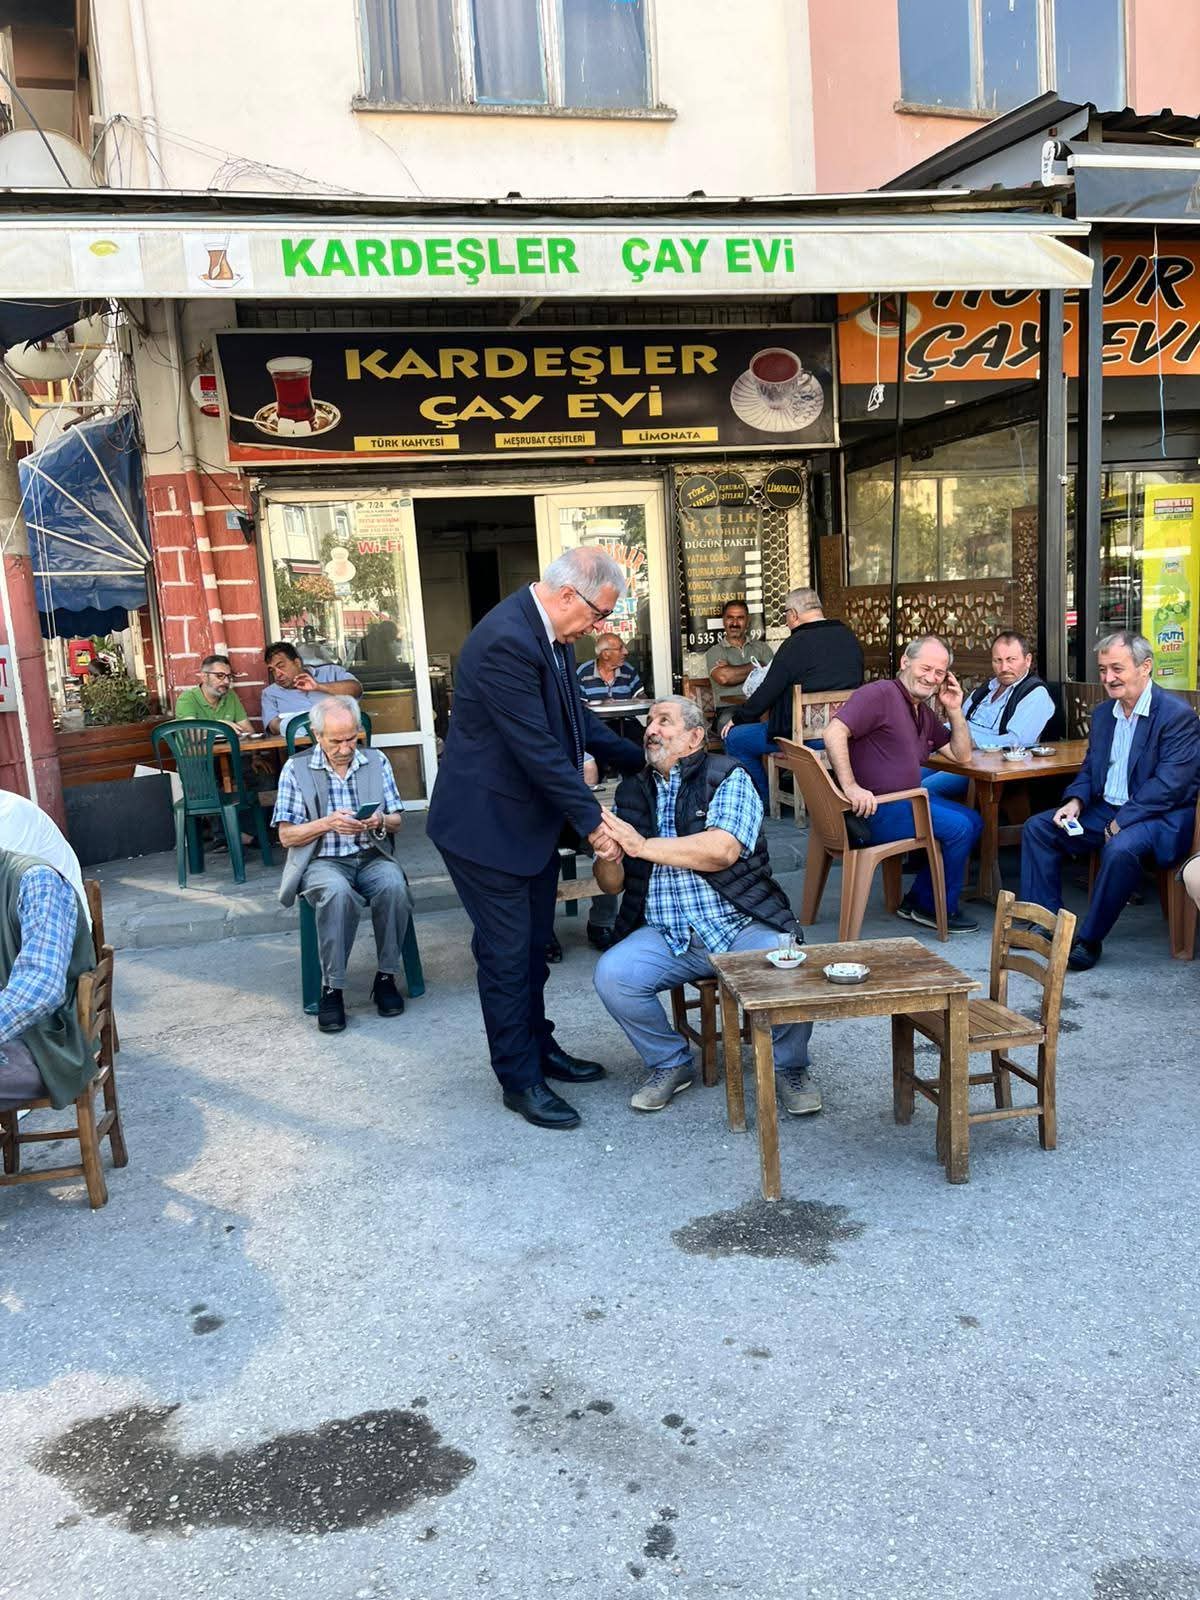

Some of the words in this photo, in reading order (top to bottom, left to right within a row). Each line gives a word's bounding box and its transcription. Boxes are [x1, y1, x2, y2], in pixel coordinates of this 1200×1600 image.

[281, 238, 580, 285] KARDEŞLER
[621, 238, 710, 283] ÇAY
[345, 345, 718, 385] KARDEŞLER
[419, 394, 544, 429] ÇAY
[567, 385, 662, 418] EVİ
[371, 437, 399, 448] TÜRK
[401, 436, 444, 448] KAHVESİ
[503, 435, 546, 446] MEŞRUBAT
[548, 433, 586, 445] ÇEŞİTLERİ
[639, 431, 701, 441] LİMONATA
[687, 484, 708, 499] TÜRK
[767, 482, 800, 494] LİMONATA
[368, 501, 384, 509] 7/24
[688, 490, 717, 508] AHVESİ
[358, 539, 401, 554] Wi-Fi
[689, 633, 695, 645] 0
[697, 632, 714, 644] 535
